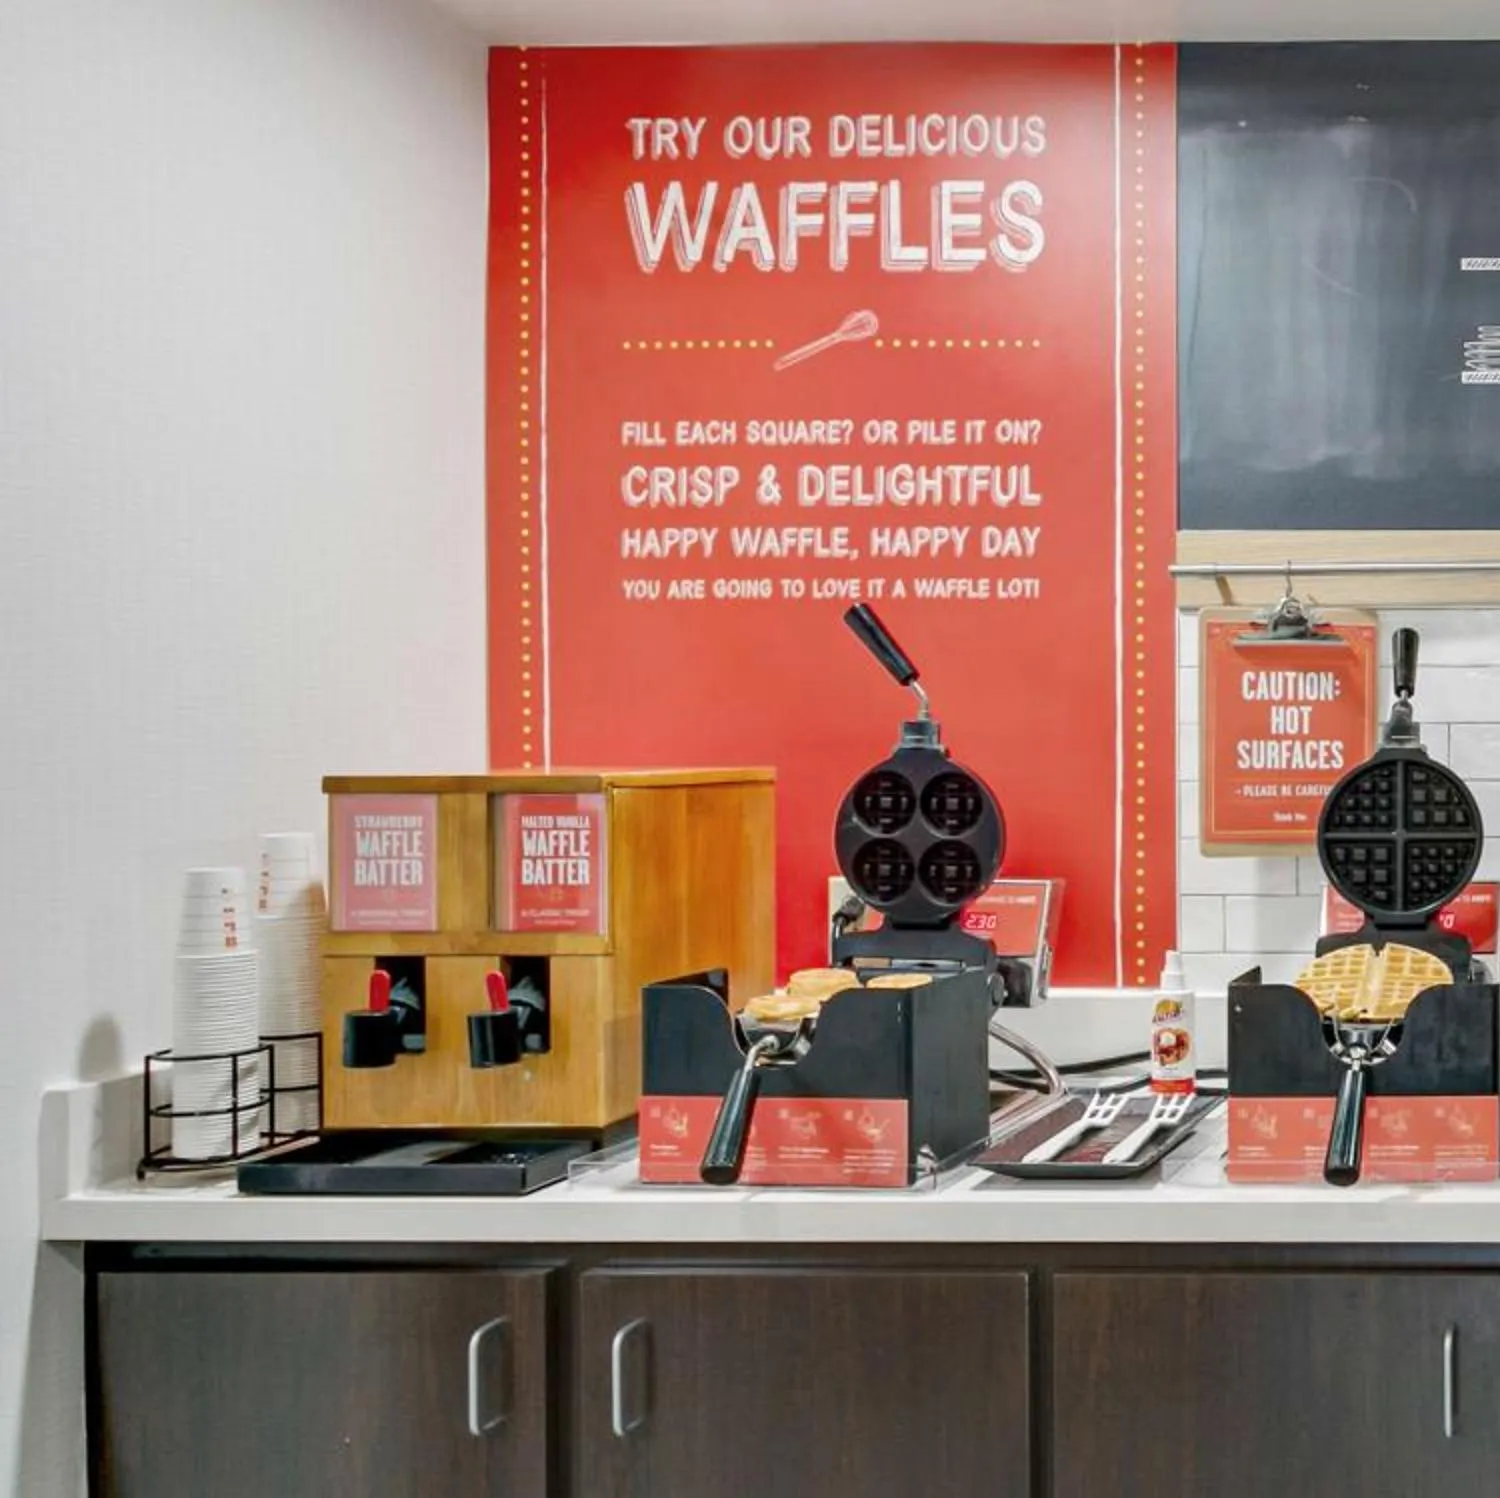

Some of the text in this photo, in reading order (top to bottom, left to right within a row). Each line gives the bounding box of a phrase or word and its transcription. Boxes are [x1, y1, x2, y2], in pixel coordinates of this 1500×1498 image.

[625, 113, 1047, 160] TRY OUR DELICIOUS
[624, 180, 1046, 273] WAFFLES
[621, 418, 1042, 447] FILL EACH SQUARE? OR PILE IT ON?
[621, 463, 1041, 508] CRISP & DELIGHTFUL
[621, 526, 1041, 561] HAPPY WAFFLE, HAPPY DAY
[623, 579, 661, 599] YOU
[667, 579, 705, 599] ARE
[713, 578, 773, 599] GOING
[782, 578, 805, 599] TO
[812, 578, 860, 598] LOVE
[868, 578, 884, 598] IT
[891, 578, 904, 598] A
[914, 578, 990, 598] WAFFLE
[1241, 671, 1341, 701] CAUTION:
[1270, 706, 1313, 735] HOT
[1236, 740, 1345, 769] SURFACES
[355, 830, 425, 857] WAFFLE
[522, 829, 591, 857] WAFFLE
[354, 859, 424, 887] BATTER
[521, 858, 591, 886] BATTER
